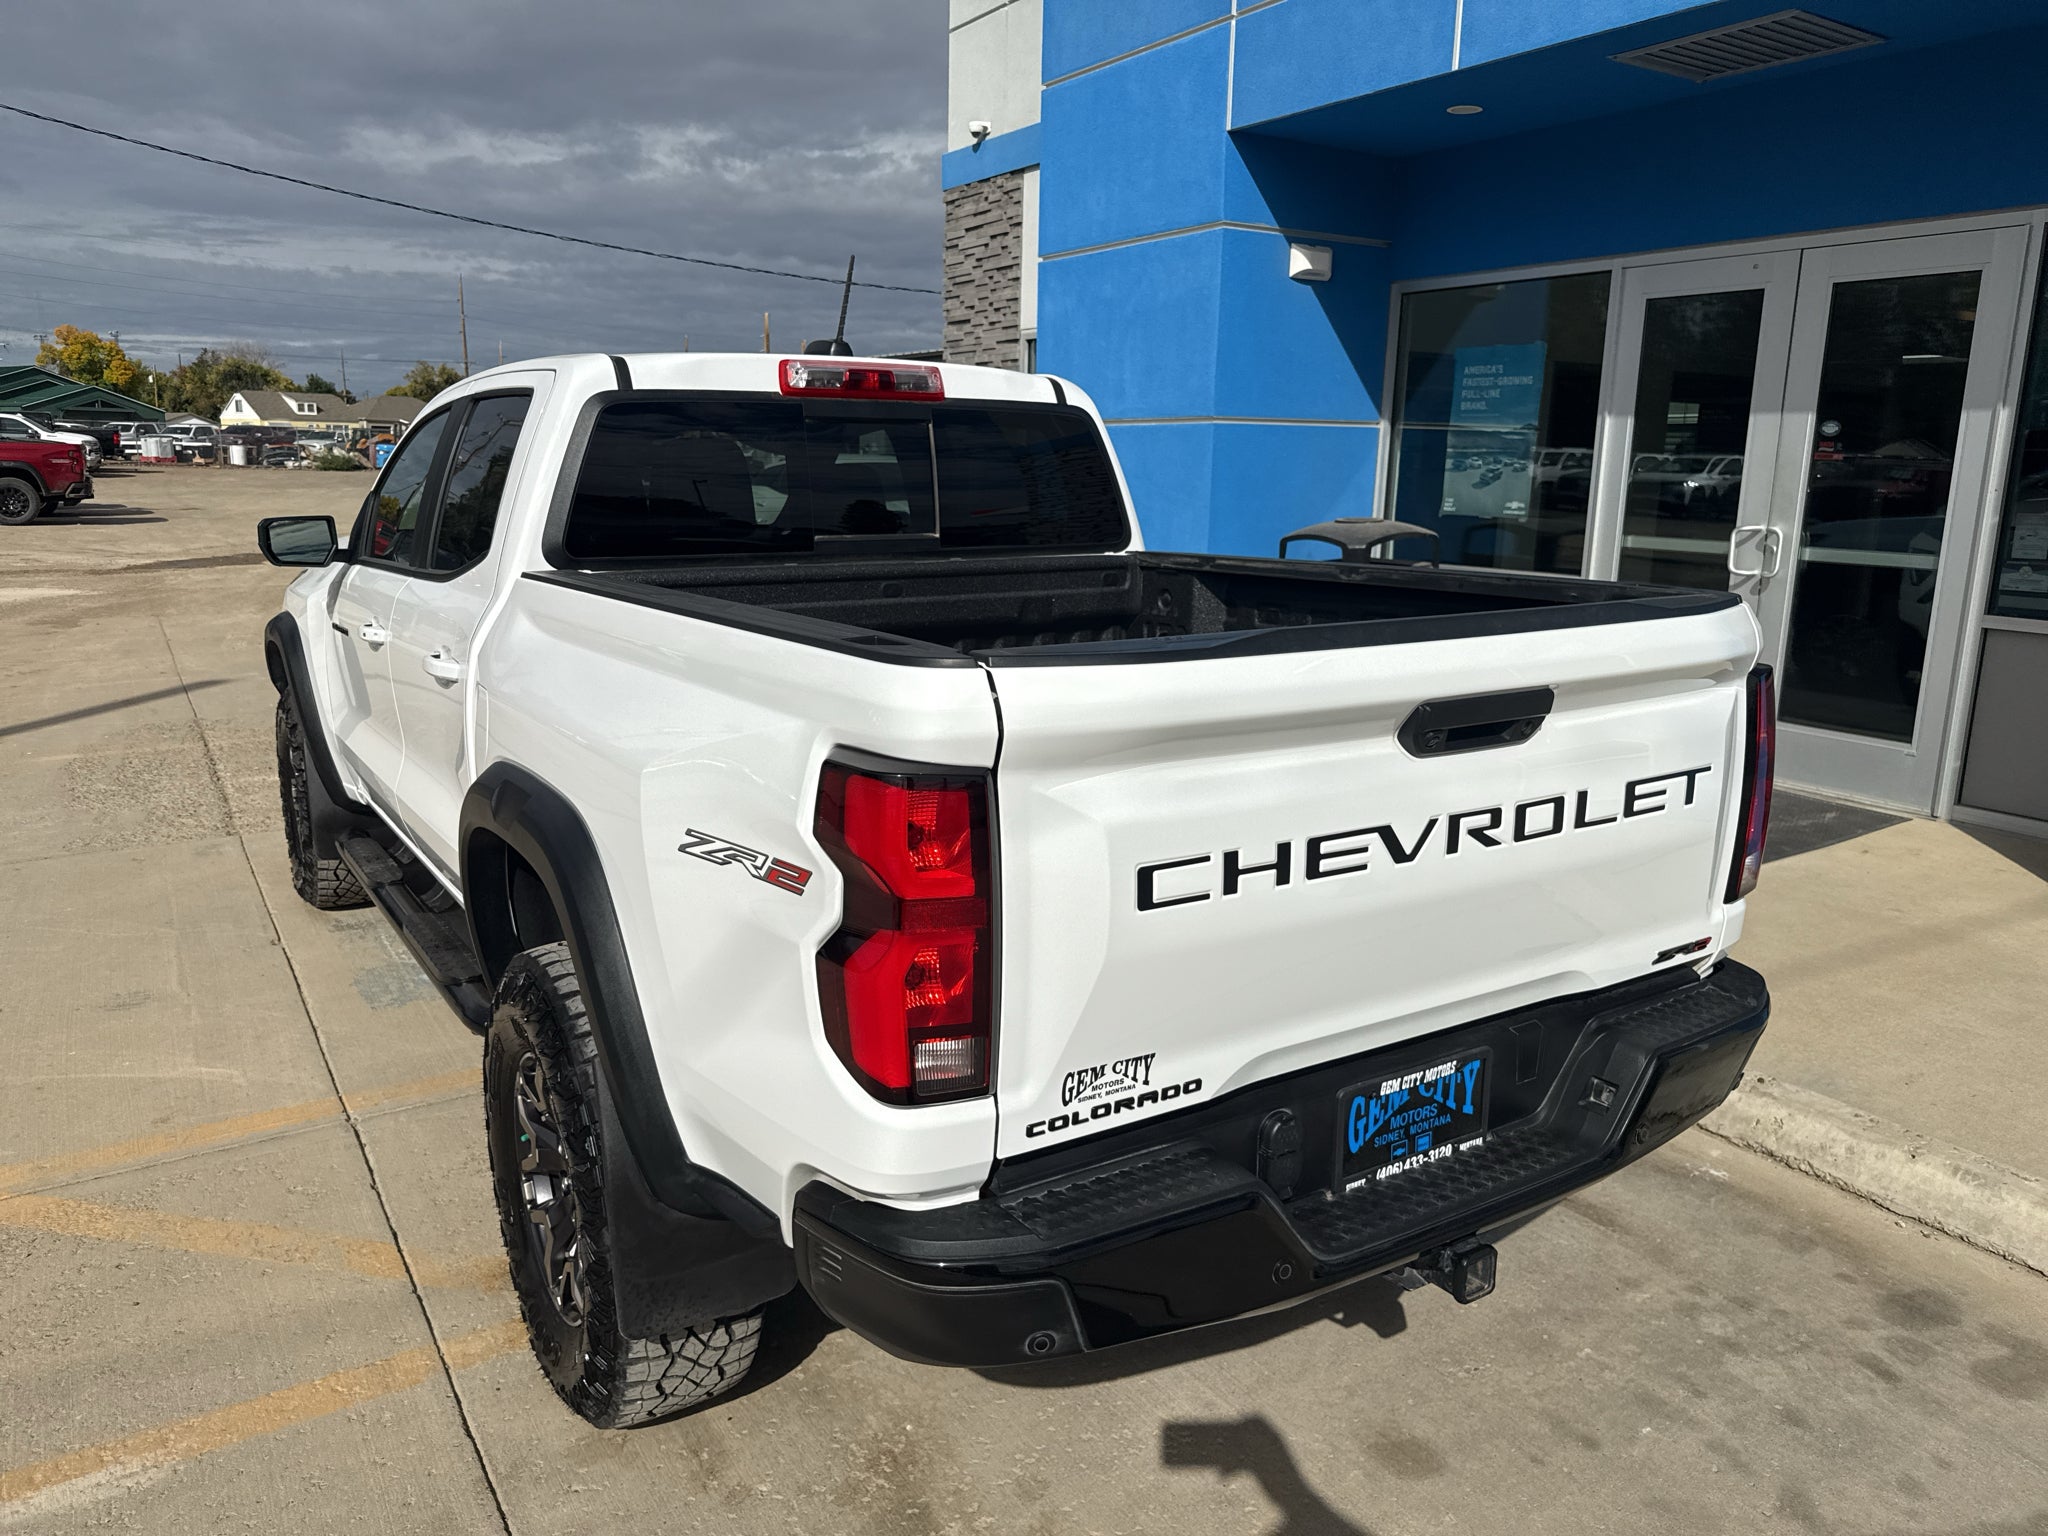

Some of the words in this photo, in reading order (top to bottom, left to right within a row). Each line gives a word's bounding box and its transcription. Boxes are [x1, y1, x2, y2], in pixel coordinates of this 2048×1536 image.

[1463, 364, 1504, 375] AMERICA'S
[1136, 765, 1712, 912] CHEVROLET
[677, 827, 813, 897] ZR2
[1061, 1063, 1108, 1107] GEM
[1111, 1052, 1156, 1086] CITY
[1091, 1078, 1125, 1092] MOTORS
[1105, 1083, 1136, 1096] MONTANA
[1379, 1077, 1402, 1096] GEM
[1402, 1071, 1424, 1089] CITY
[1424, 1060, 1457, 1083] MOTORS
[1025, 1077, 1203, 1138] COLORADO
[1389, 1103, 1438, 1130] MOTORS
[1409, 1113, 1452, 1136] MONTANA
[1376, 1161, 1403, 1181] (406)
[1403, 1143, 1453, 1171] 433-3120
